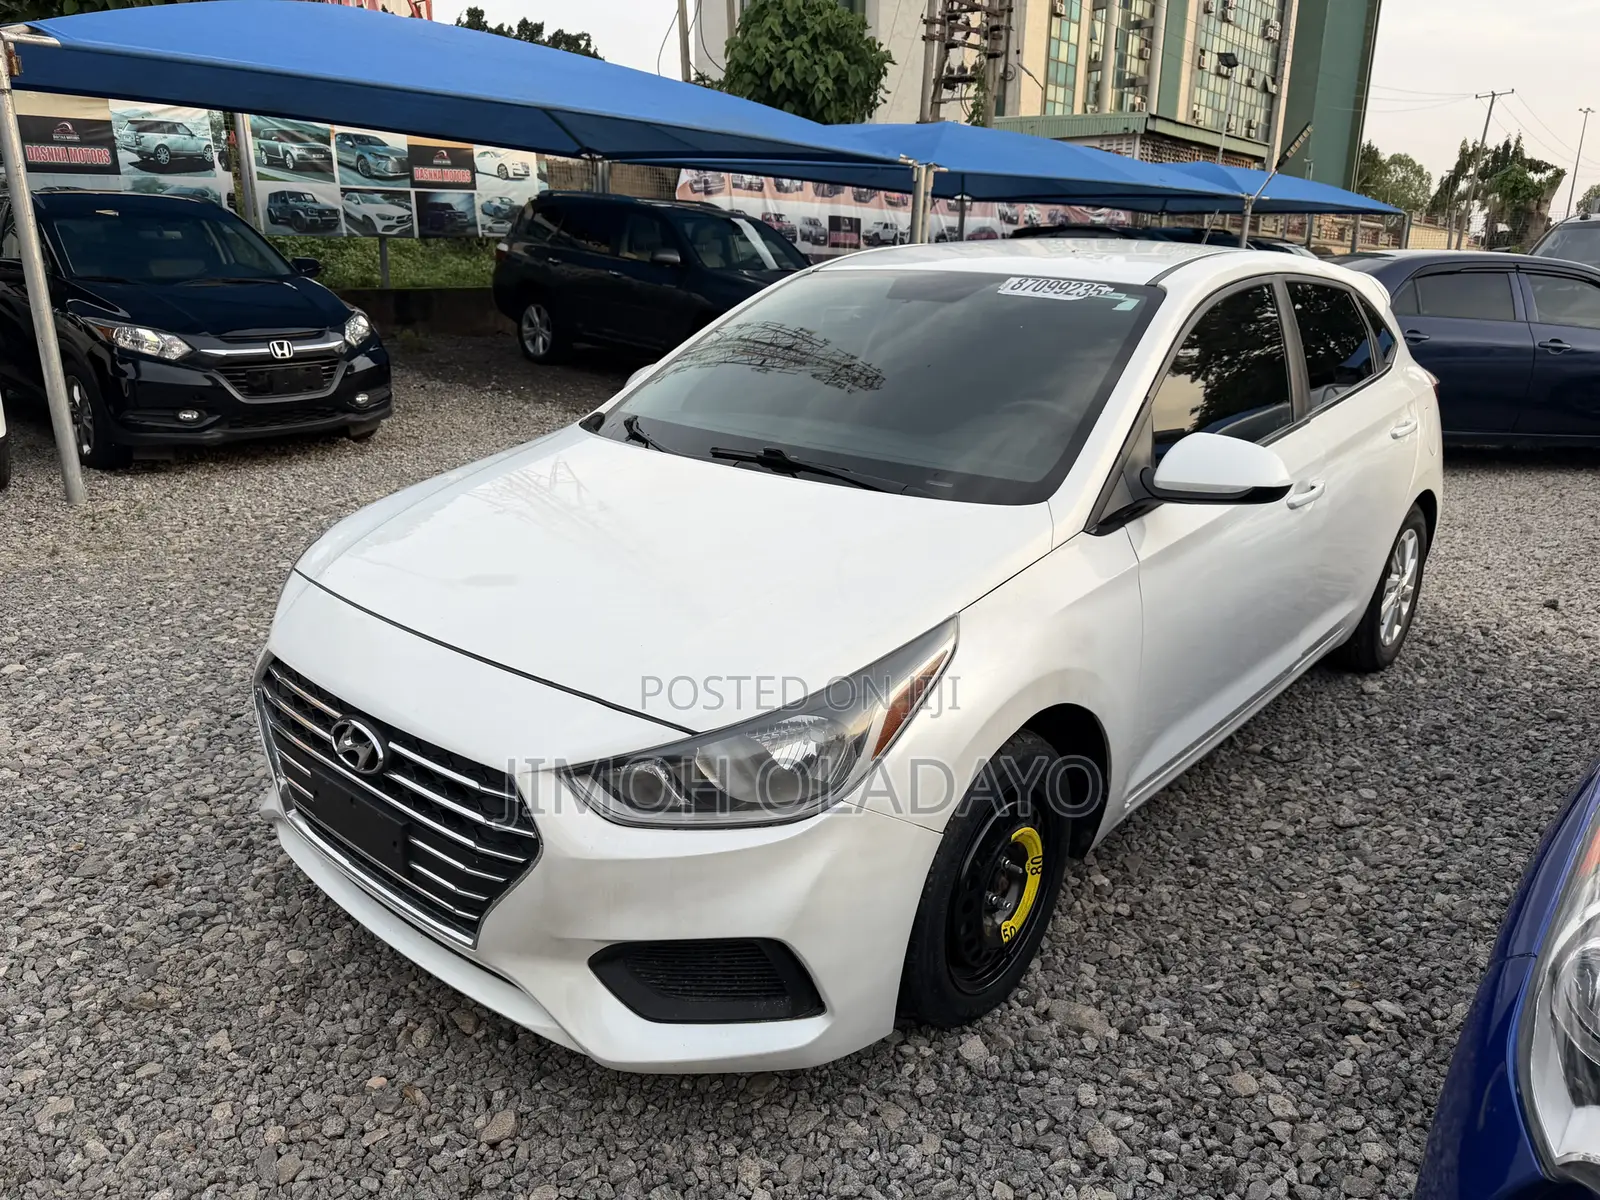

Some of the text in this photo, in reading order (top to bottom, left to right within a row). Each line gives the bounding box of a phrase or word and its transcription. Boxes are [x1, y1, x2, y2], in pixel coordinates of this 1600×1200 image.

[25, 145, 111, 165] DASNNA MOTORS
[442, 168, 471, 183] MOTORS
[1030, 855, 1043, 875] 80
